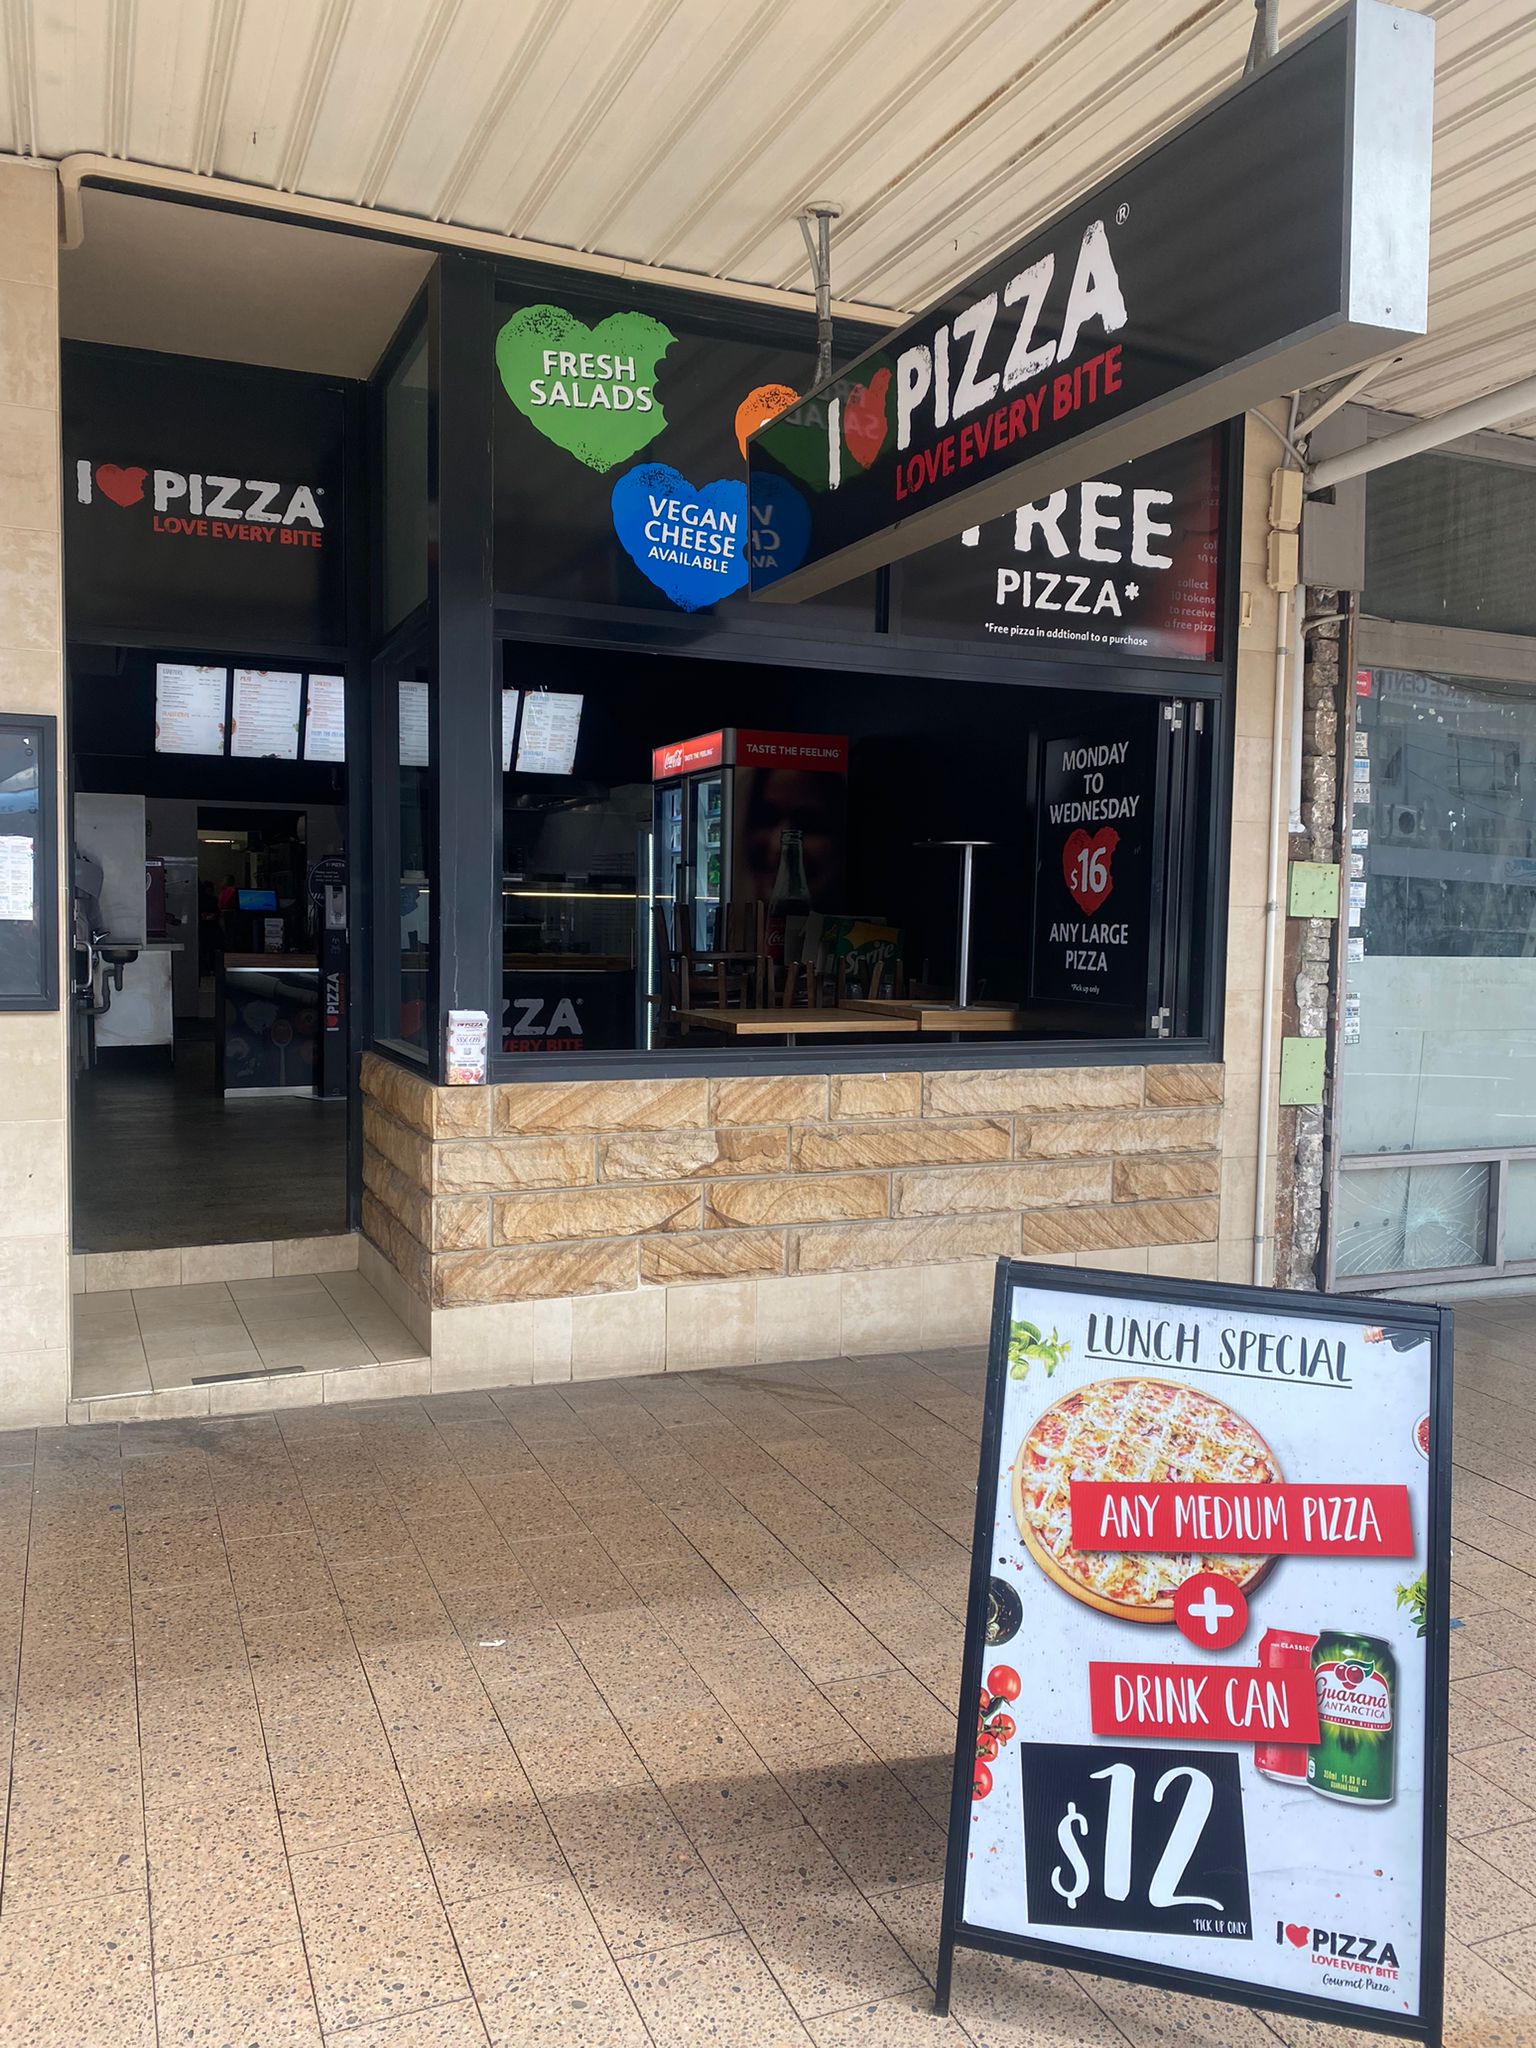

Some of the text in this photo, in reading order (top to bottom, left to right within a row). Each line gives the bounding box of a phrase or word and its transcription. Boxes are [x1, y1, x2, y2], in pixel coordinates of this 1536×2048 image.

[542, 350, 636, 382] FRESH
[529, 379, 654, 413] SALADS
[896, 438, 954, 501] LOVE
[960, 385, 1047, 469] EVERY
[1053, 344, 1122, 422] BITE
[828, 398, 841, 490] I
[76, 459, 92, 505] I
[647, 494, 738, 535] VEGAN
[961, 481, 1174, 570] REE
[153, 514, 322, 548] LOVE EVERY BITE
[643, 521, 736, 559] CHEESE
[647, 544, 729, 575] AVAILABLE
[1182, 605, 1215, 618] receive
[1183, 591, 1215, 604] tokens
[1010, 625, 1035, 637] pizza
[1036, 627, 1045, 637] in
[1091, 633, 1101, 642] to
[1102, 635, 1108, 643] a
[1109, 635, 1148, 646] purchase
[1172, 618, 1192, 630] free
[746, 743, 839, 758] TASTE THE FEELING
[1062, 741, 1129, 771] MONDAY
[1083, 772, 1104, 795] TO
[1049, 795, 1139, 824] WEDNESDAY
[1070, 847, 1107, 893] $16
[1049, 923, 1128, 945] ANY LARGE
[1065, 950, 1108, 972] PIZZA
[326, 972, 340, 1014] PIZZA
[1087, 1313, 1353, 1383] LUNCH SPECIAL
[1099, 1493, 1383, 1543] ANY MEDIUM PIZZA
[1280, 1642, 1310, 1652] CLASSIC
[1114, 1673, 1290, 1730] DRINK CAN
[1316, 1676, 1388, 1708] Guaraná
[1323, 1701, 1386, 1720] ANTARCTICA
[1050, 1762, 1225, 1910] $12
[1215, 1920, 1225, 1933] UP
[1227, 1920, 1248, 1935] ONLY
[1276, 1920, 1400, 1968] I PIZZA
[1312, 1954, 1399, 1980] LOVE EVERY BITE
[1322, 1973, 1390, 1993] Gourmet Pizza
